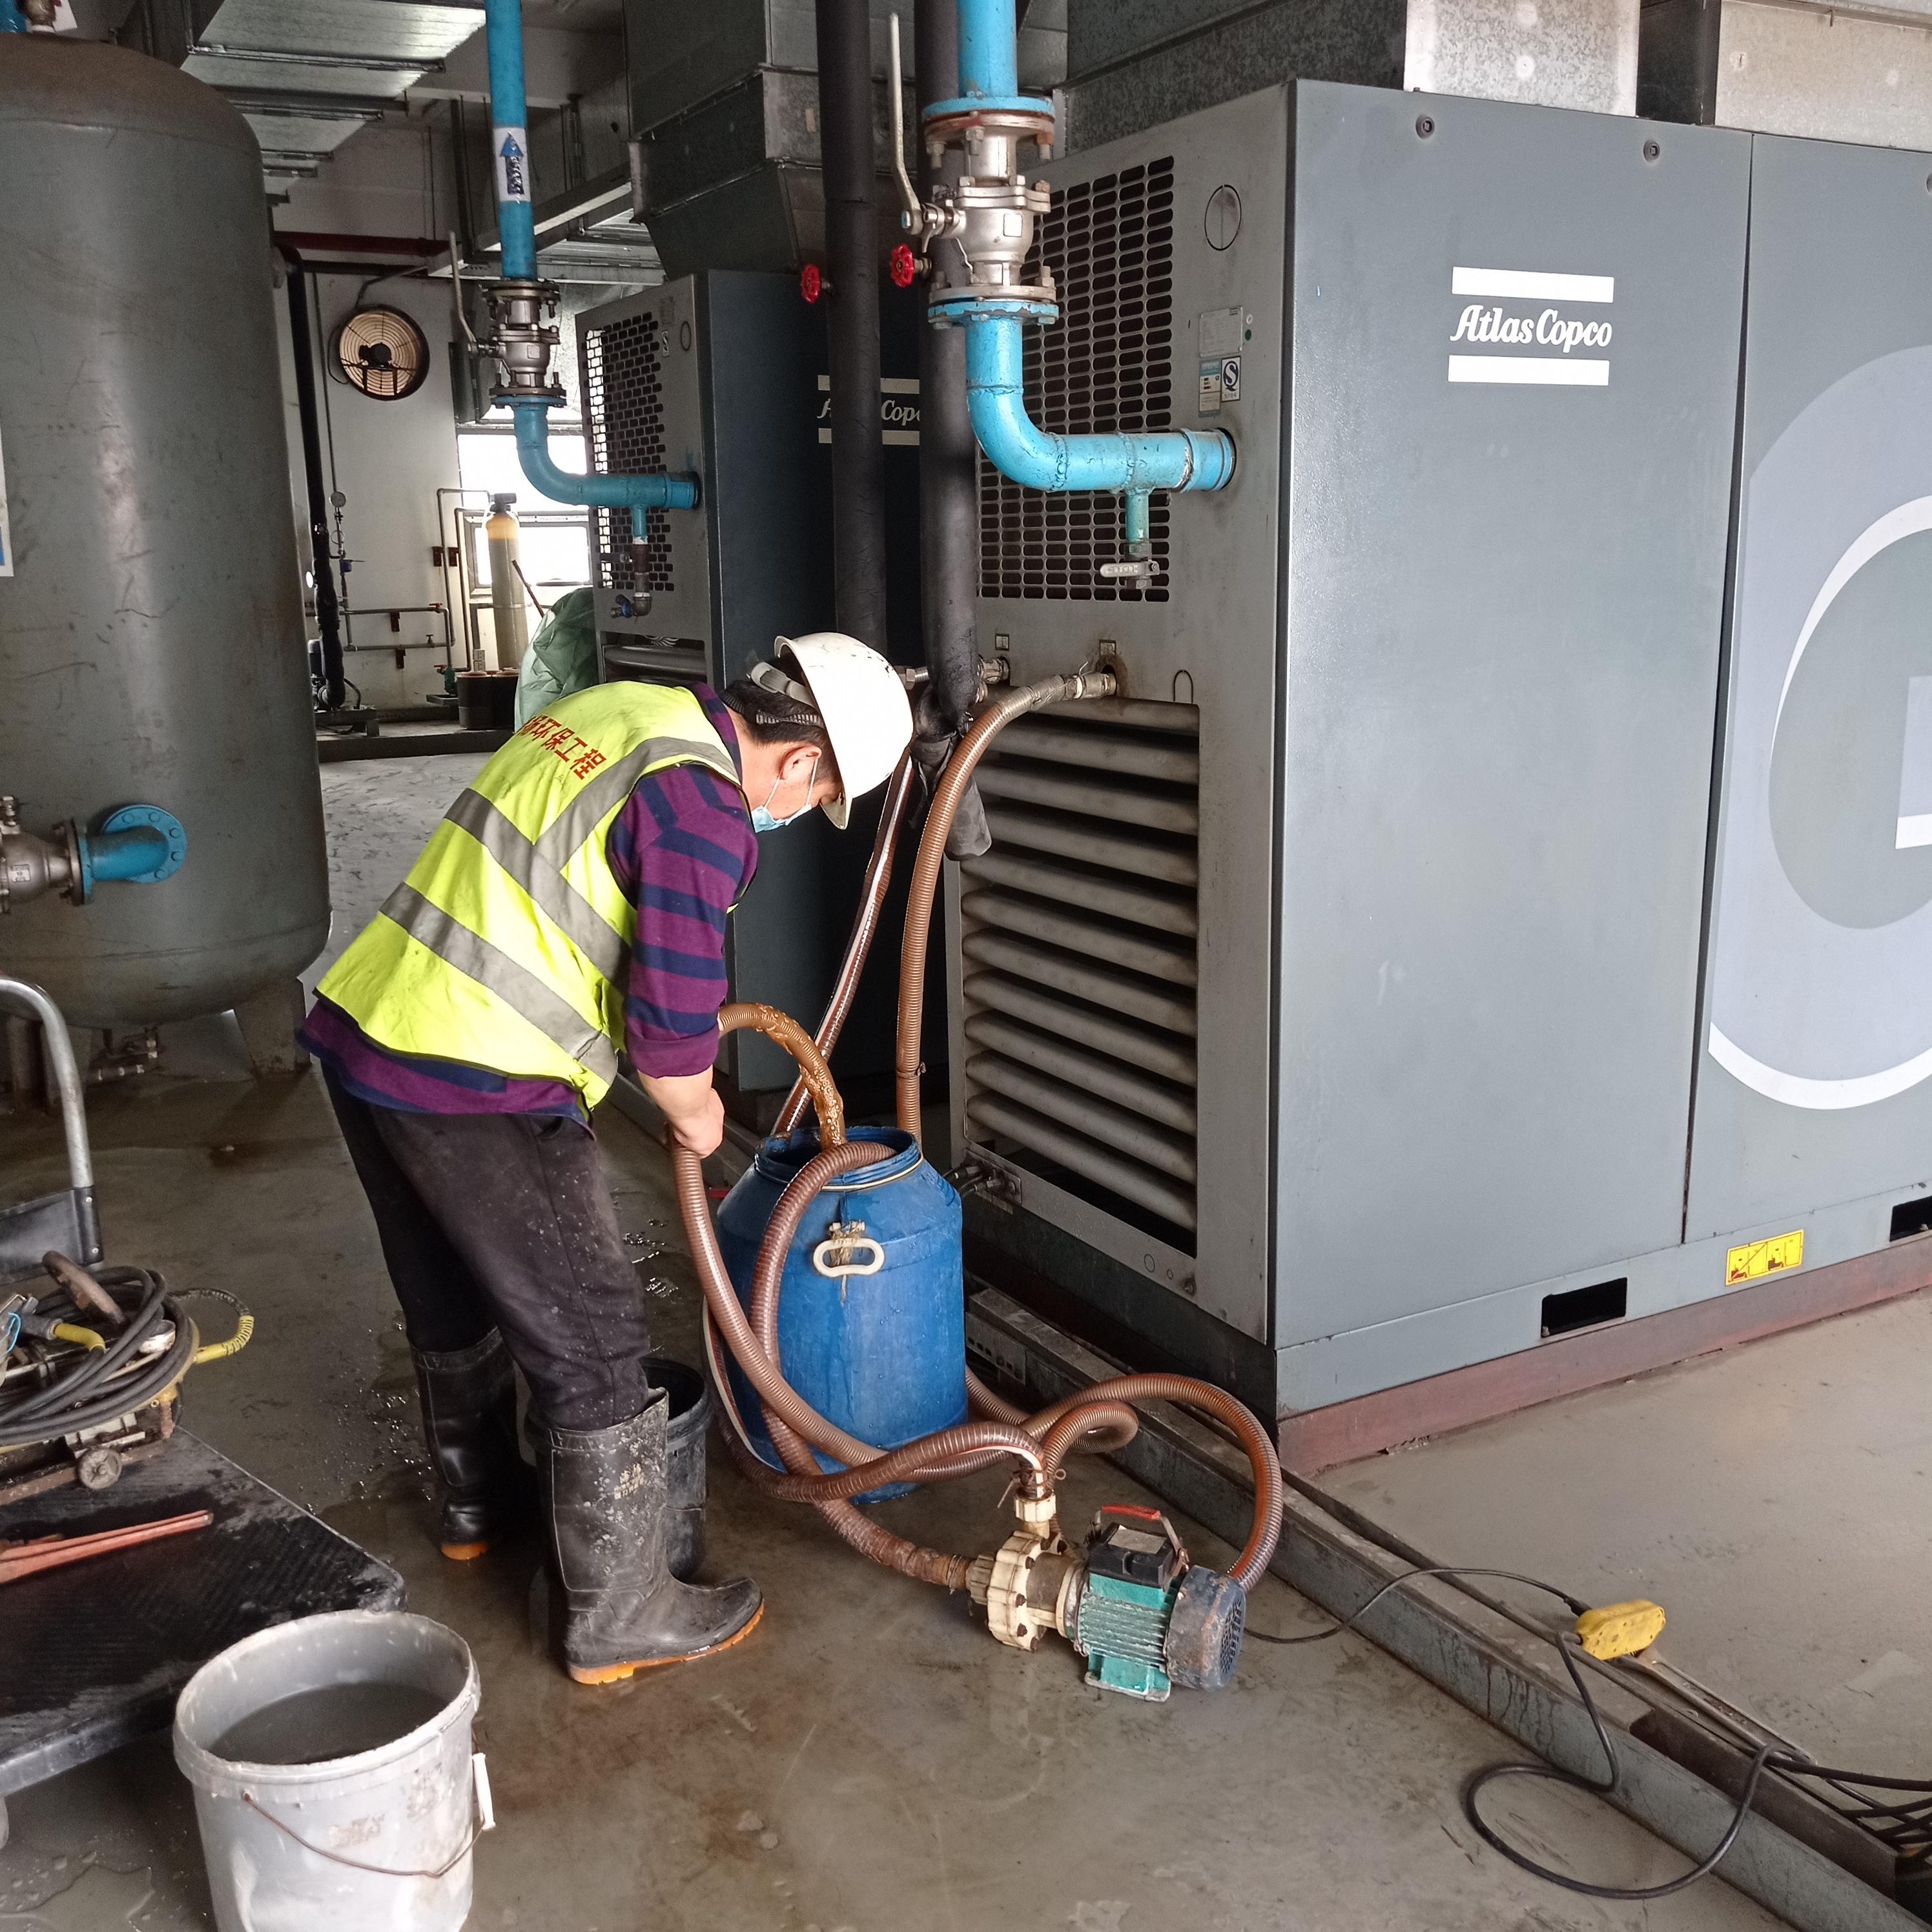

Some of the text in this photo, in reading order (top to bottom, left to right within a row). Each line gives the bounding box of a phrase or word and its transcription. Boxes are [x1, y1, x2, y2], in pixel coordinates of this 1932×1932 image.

[1450, 305, 1612, 353] Atlas Copco
[881, 399, 920, 426] Cop
